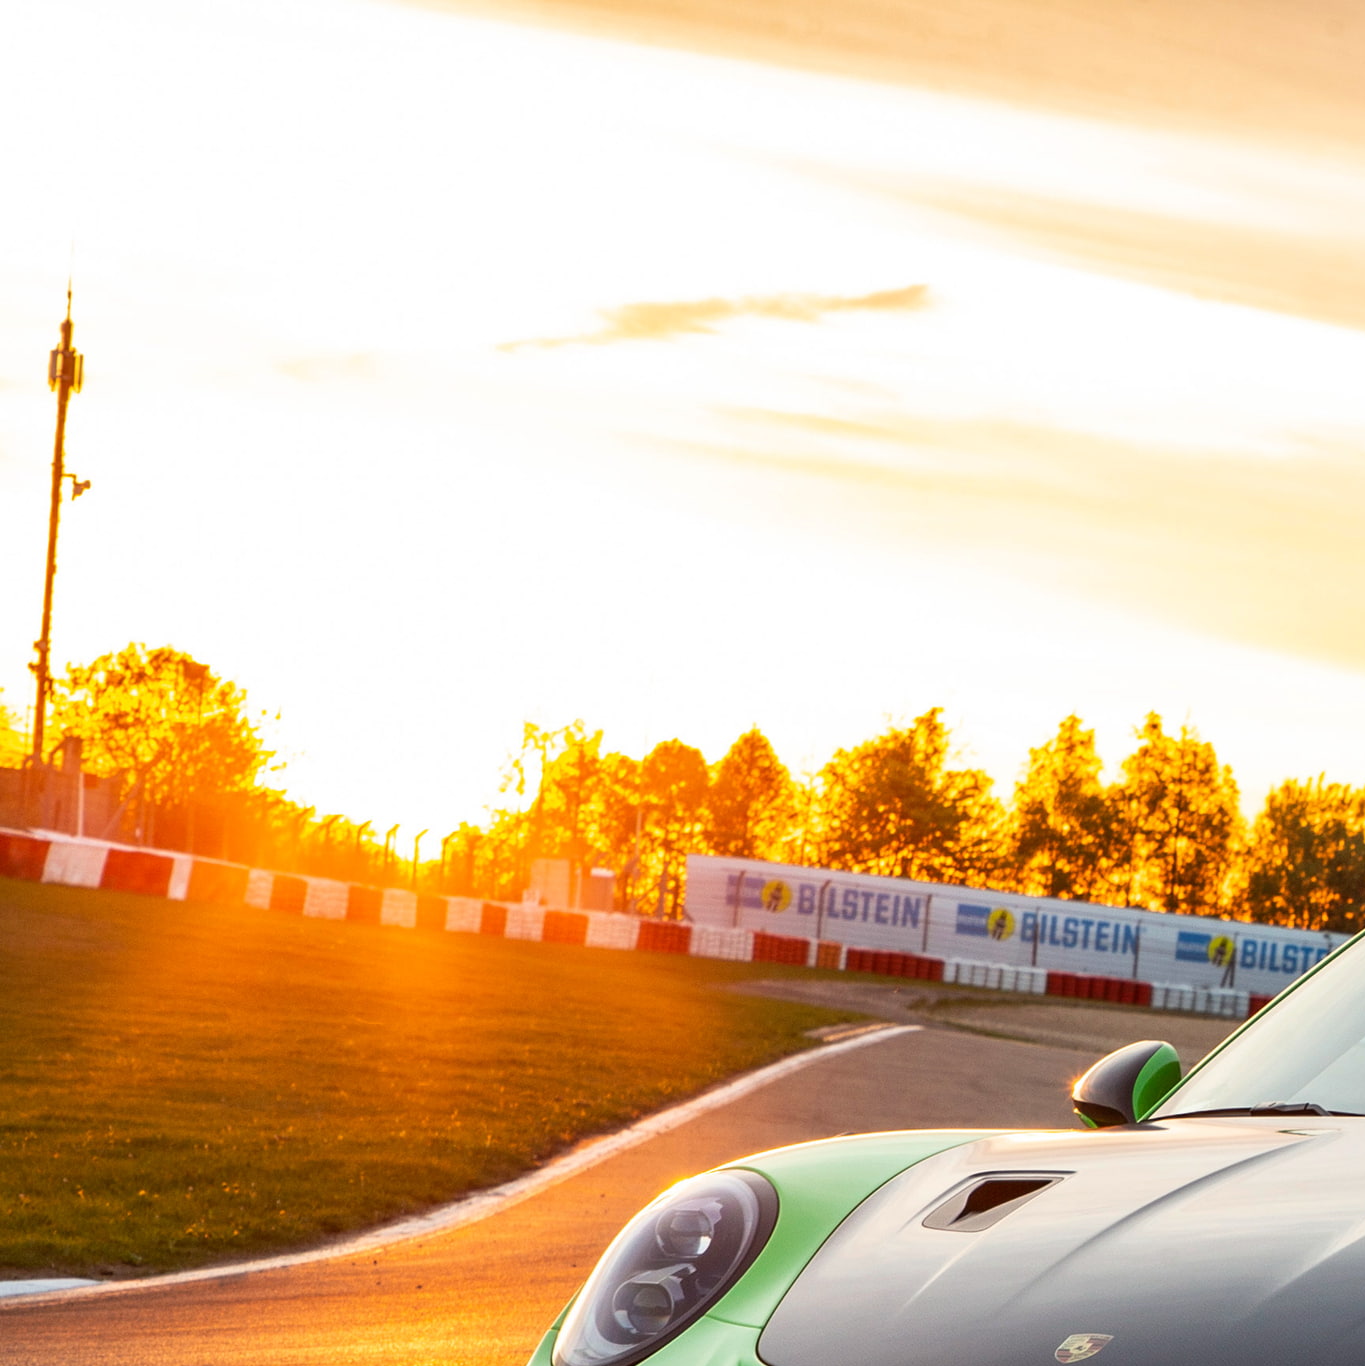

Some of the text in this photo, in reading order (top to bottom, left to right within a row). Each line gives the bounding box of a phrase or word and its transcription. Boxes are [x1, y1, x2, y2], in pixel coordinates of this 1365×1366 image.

[797, 882, 921, 928] BLSTEIN
[1020, 912, 1140, 956] BILSTEIN
[1240, 939, 1332, 974] BILST
